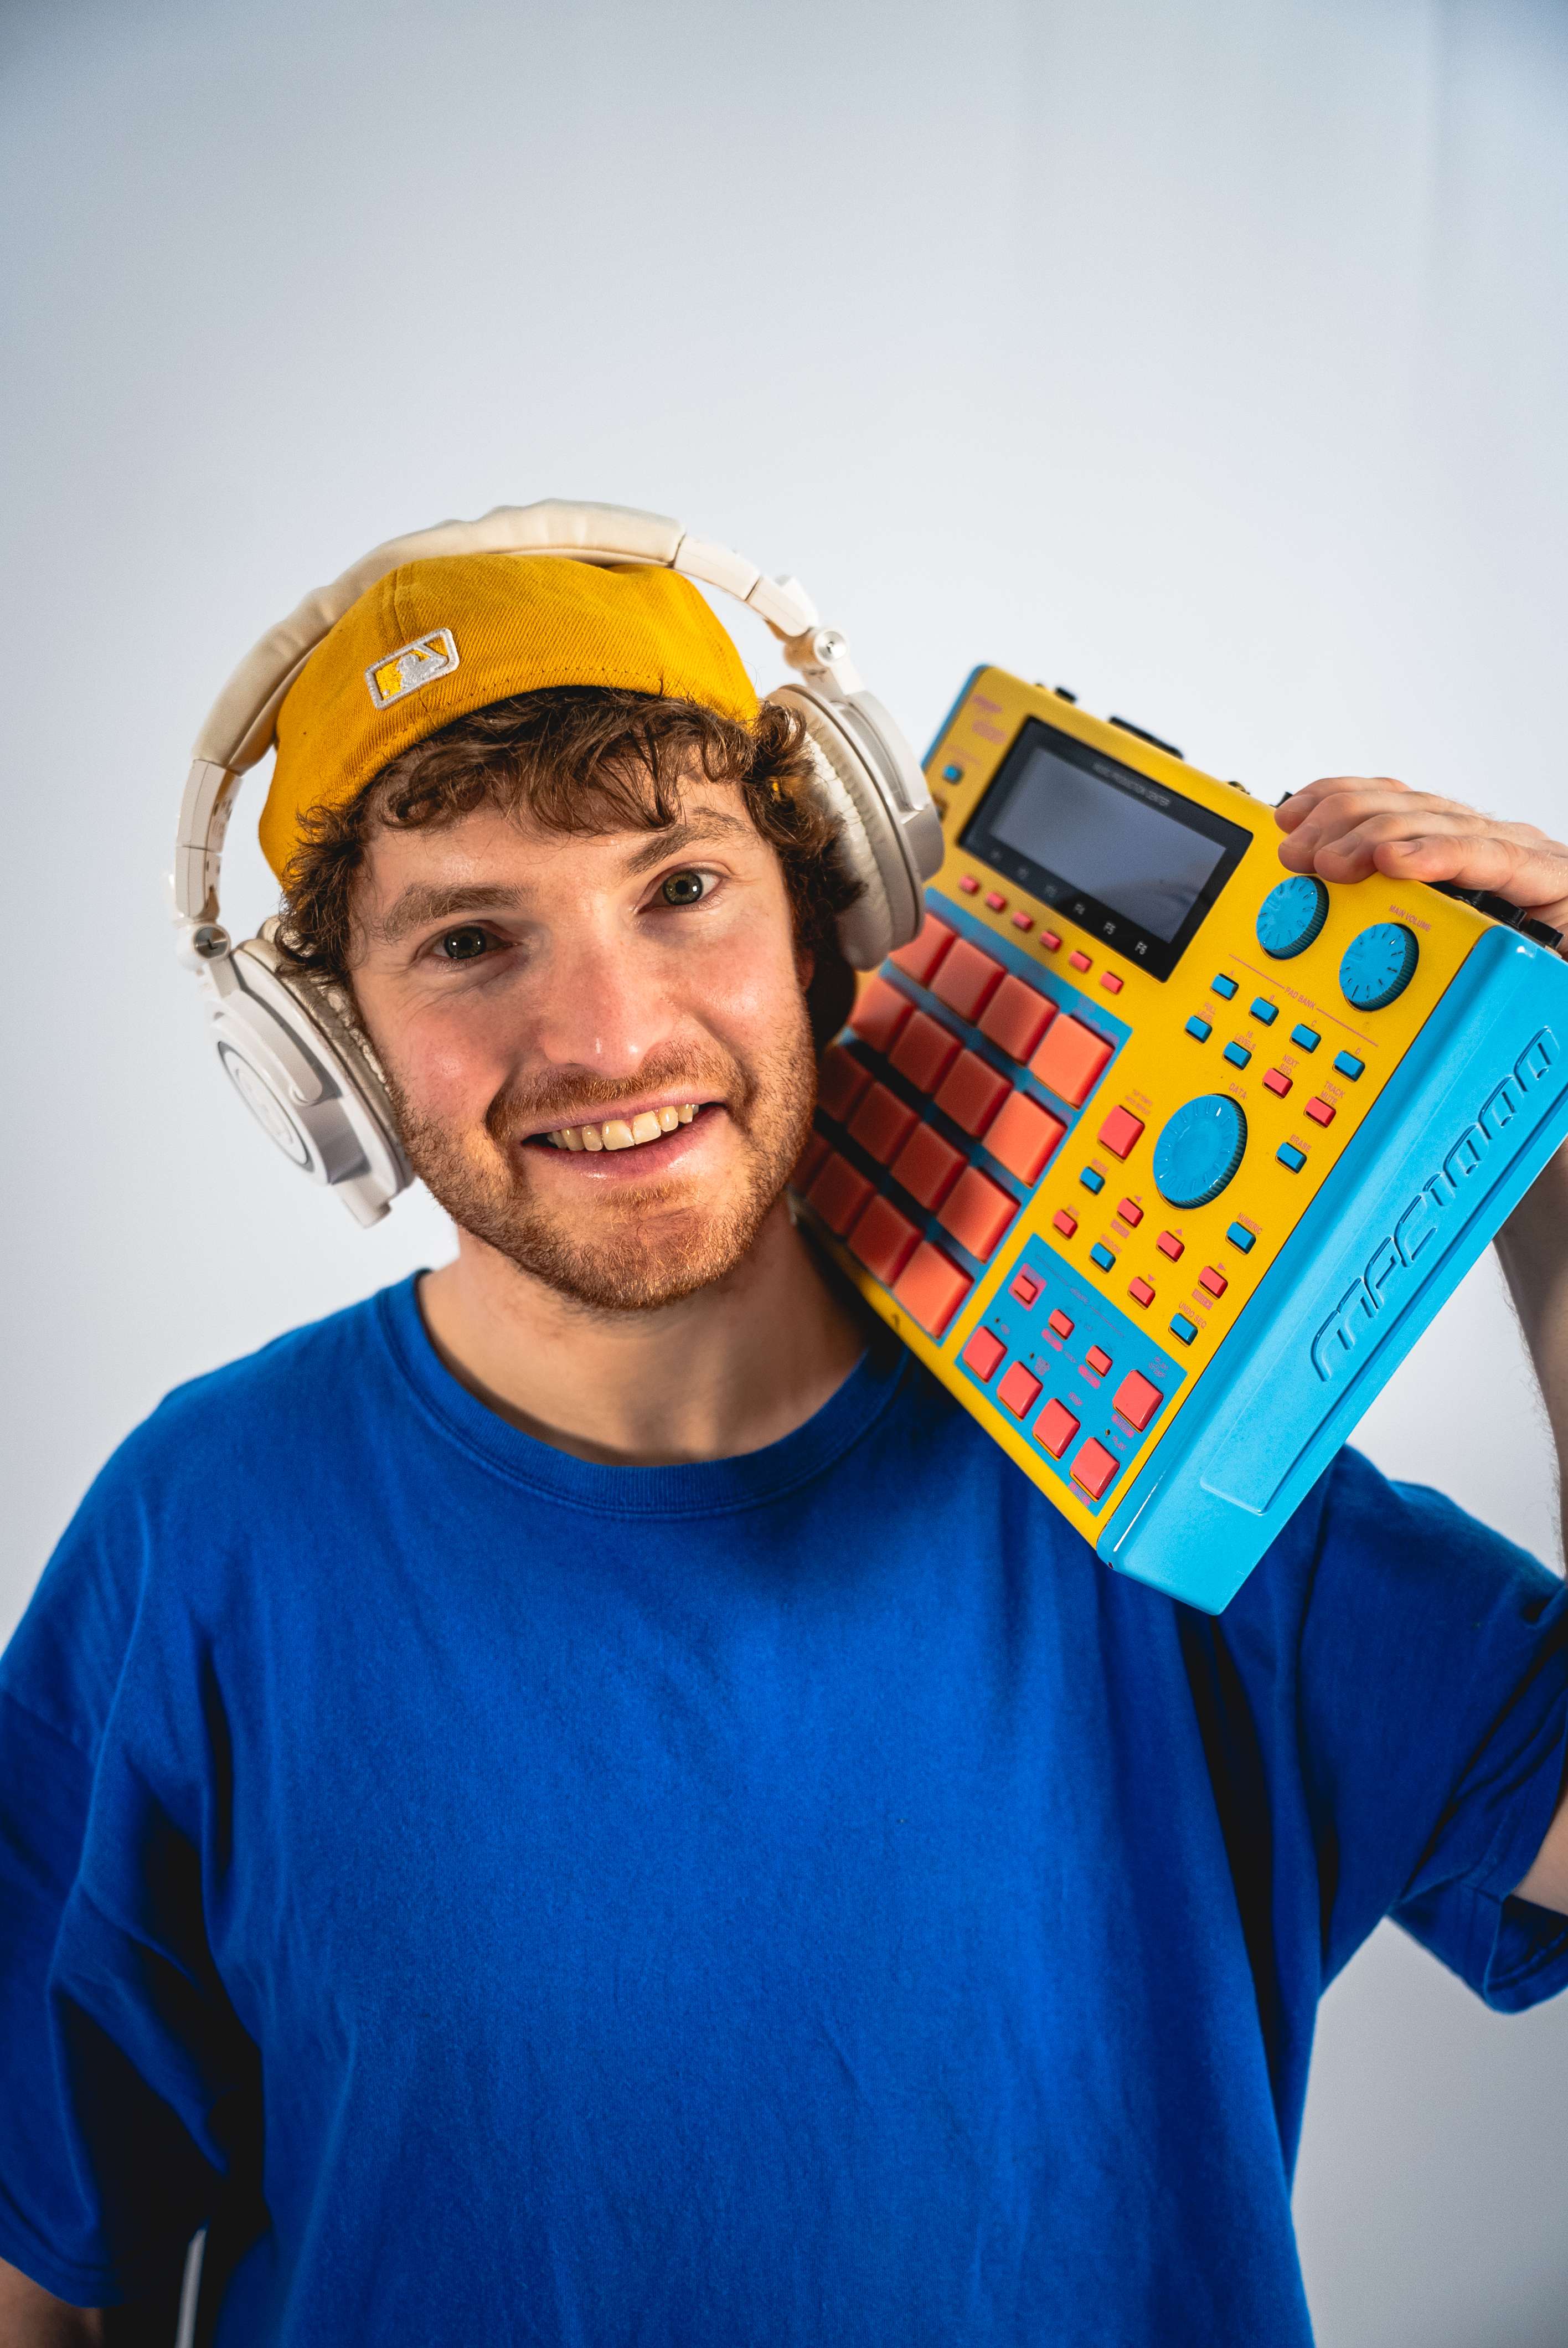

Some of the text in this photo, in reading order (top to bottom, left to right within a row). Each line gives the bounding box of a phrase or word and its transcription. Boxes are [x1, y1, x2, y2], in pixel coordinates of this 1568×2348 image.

[1390, 904, 1431, 932] MAIN VOLUME
[1104, 921, 1116, 935] F5
[1134, 940, 1147, 955] F6
[1285, 987, 1316, 1009] PAD BANK
[1235, 1034, 1256, 1051] LEVELS
[1280, 1063, 1292, 1076] SEQ
[1282, 1054, 1299, 1068] NEXT
[1229, 1083, 1247, 1099] DATA
[1321, 1090, 1337, 1105] MUTE
[1324, 1081, 1345, 1099] TRACK
[1290, 1134, 1311, 1152] ERASE
[1311, 1026, 1560, 1382] MPC1000
[1237, 1212, 1262, 1234] NUMERIC
[1179, 1302, 1206, 1329] UNDO SEQ
